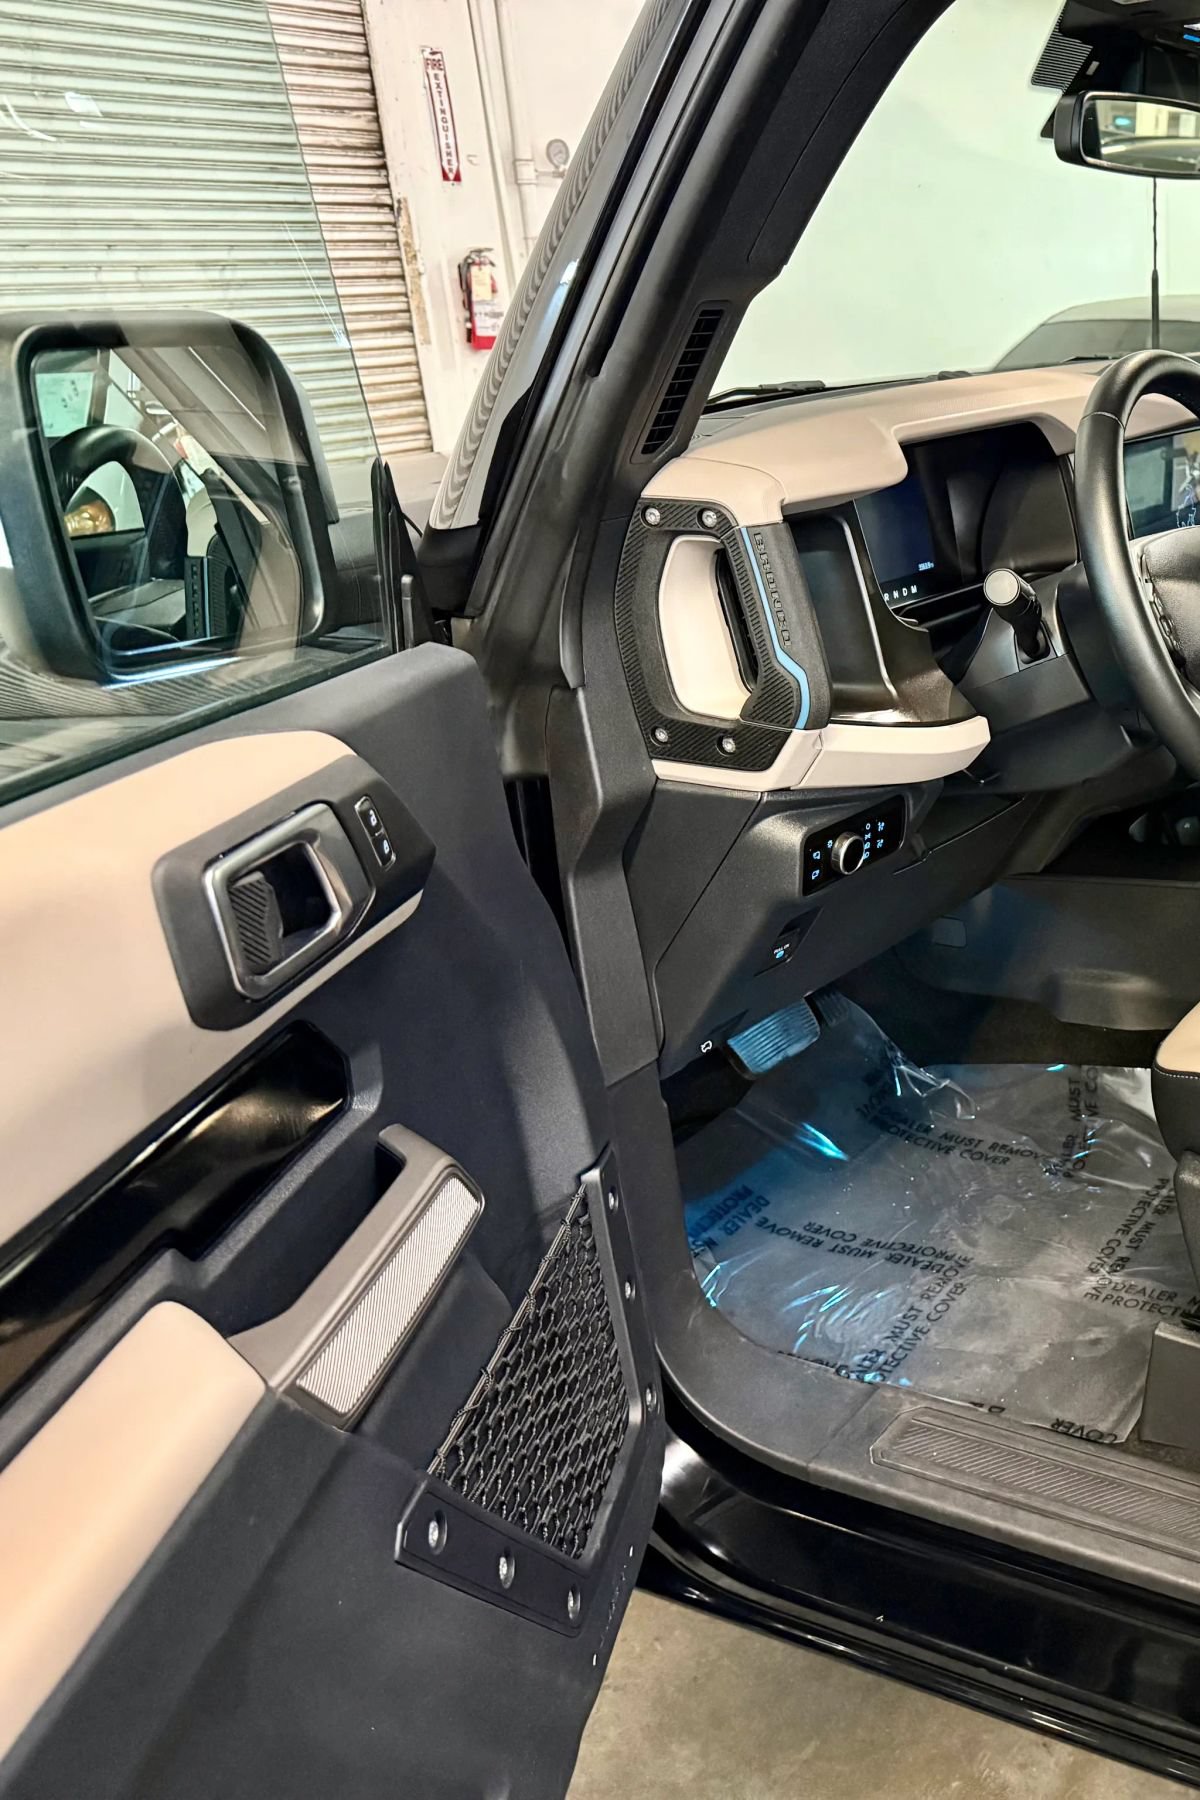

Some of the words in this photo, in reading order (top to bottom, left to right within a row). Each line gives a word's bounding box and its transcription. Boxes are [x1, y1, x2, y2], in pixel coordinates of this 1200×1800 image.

[425, 57, 444, 71] FIRE
[433, 72, 454, 174] EXTINGUISHER
[753, 532, 792, 647] BRONCO
[1069, 1078, 1081, 1121] MUST
[938, 1131, 985, 1150] MUST
[988, 1141, 1048, 1161] REMOV
[959, 1148, 1011, 1166] COVER
[719, 1195, 771, 1236] DEALER
[755, 1217, 825, 1249] REMOVE
[803, 1221, 858, 1243] COVER
[1125, 1220, 1157, 1250] MUST
[828, 1243, 878, 1260] MUST
[860, 1238, 962, 1264] PROTECTIVE
[884, 1253, 946, 1275] DEALER
[1101, 1293, 1190, 1317] PROTECT
[1111, 1281, 1178, 1303] DEALER
[877, 1325, 931, 1382] OTECTIVE
[926, 1282, 968, 1323] COVER
[881, 1305, 924, 1343] MUST
